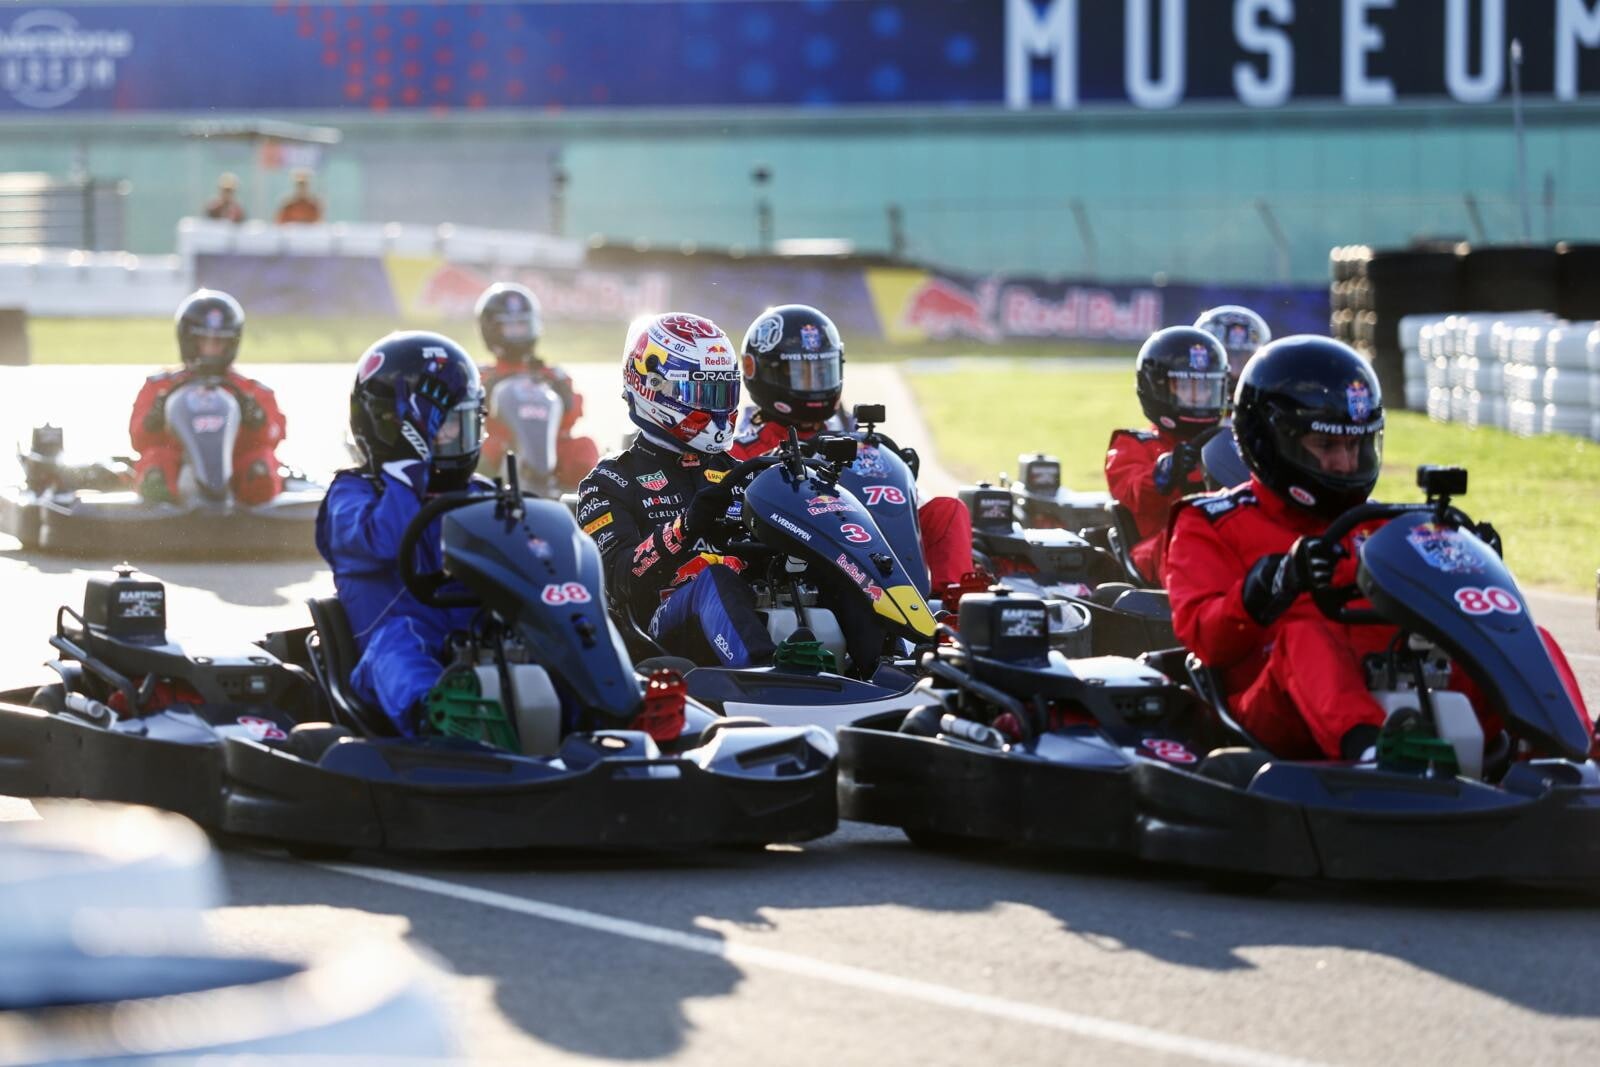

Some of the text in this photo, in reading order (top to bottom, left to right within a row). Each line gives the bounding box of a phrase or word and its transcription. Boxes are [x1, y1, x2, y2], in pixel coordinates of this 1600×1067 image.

[1002, 0, 1600, 110] MUSEUM
[803, 352, 818, 361] YOU
[692, 371, 741, 381] ORACLE
[1311, 420, 1343, 435] GIVES
[1345, 423, 1366, 436] YOU
[639, 472, 664, 483] TAG
[642, 495, 671, 509] Mobil
[862, 485, 906, 505] 78
[647, 507, 687, 520] CARLYLE
[840, 523, 872, 543] 3
[118, 590, 164, 602] KARTING
[541, 582, 592, 606] 68
[1454, 586, 1523, 615] 80
[1001, 608, 1046, 620] KARTING
